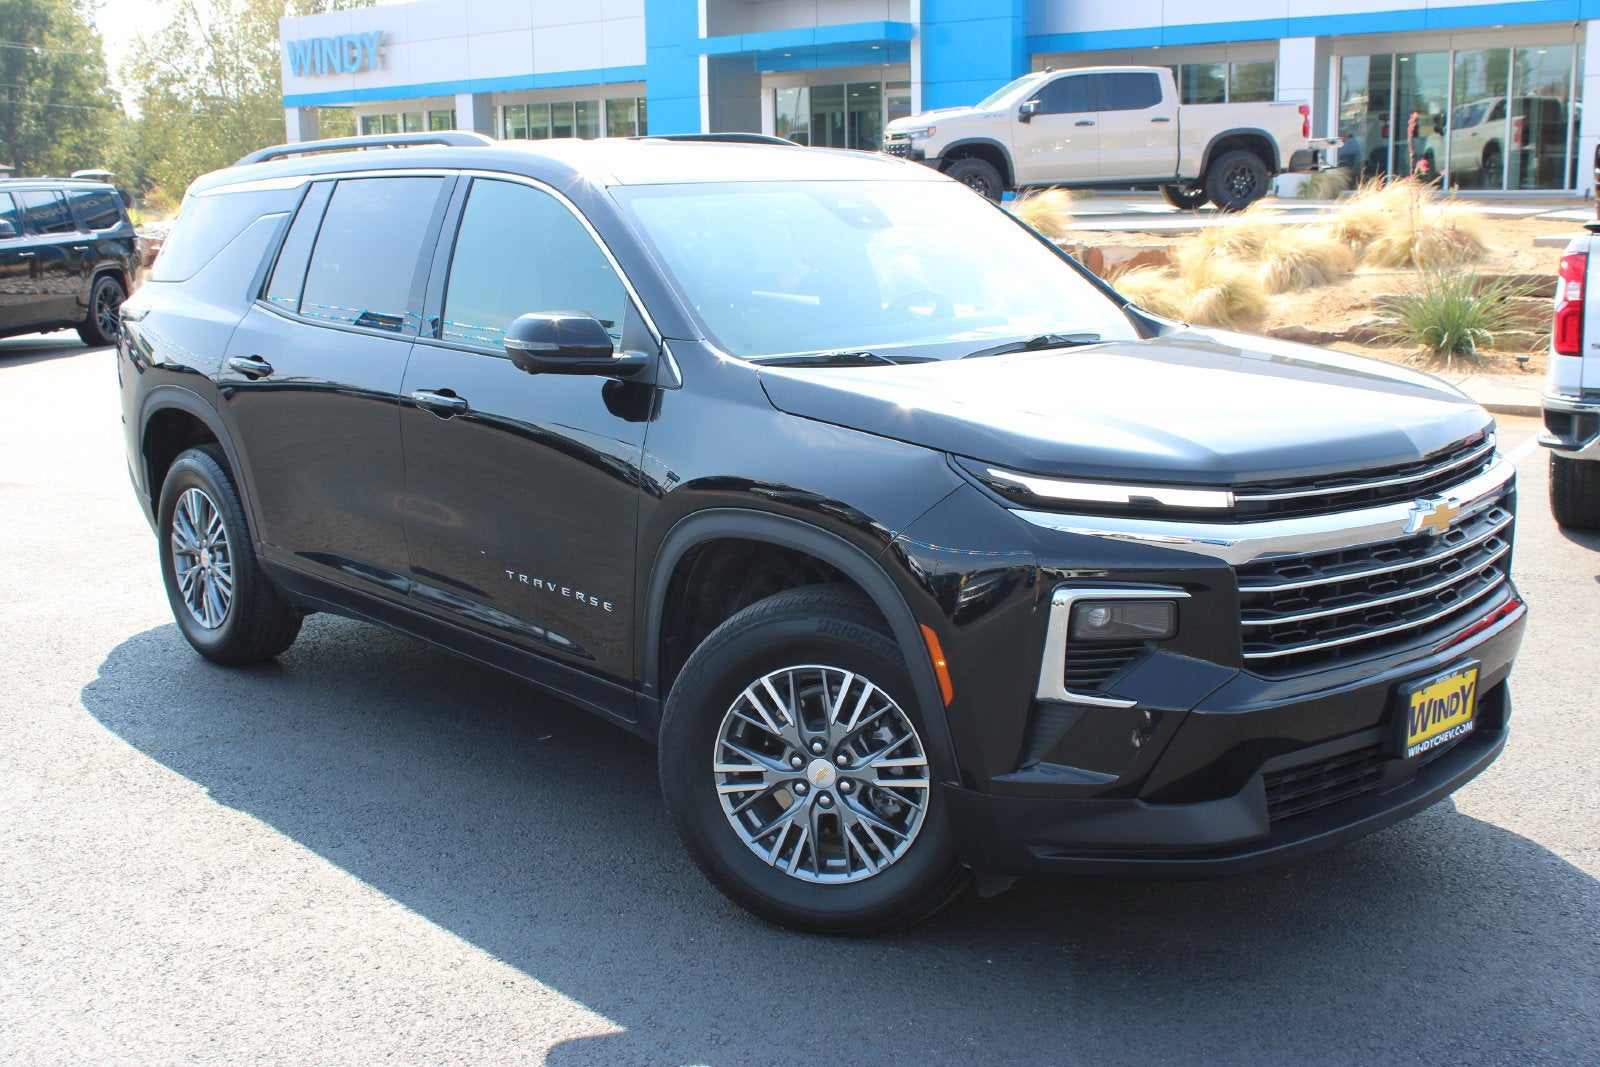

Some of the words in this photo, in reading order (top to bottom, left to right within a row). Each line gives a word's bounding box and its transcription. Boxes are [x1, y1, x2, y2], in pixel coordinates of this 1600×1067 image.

[286, 31, 383, 77] WINDY
[505, 569, 613, 612] TRAVERSE
[1408, 681, 1475, 738] WINDY
[1407, 720, 1473, 758] WINDYCHEV.COM
